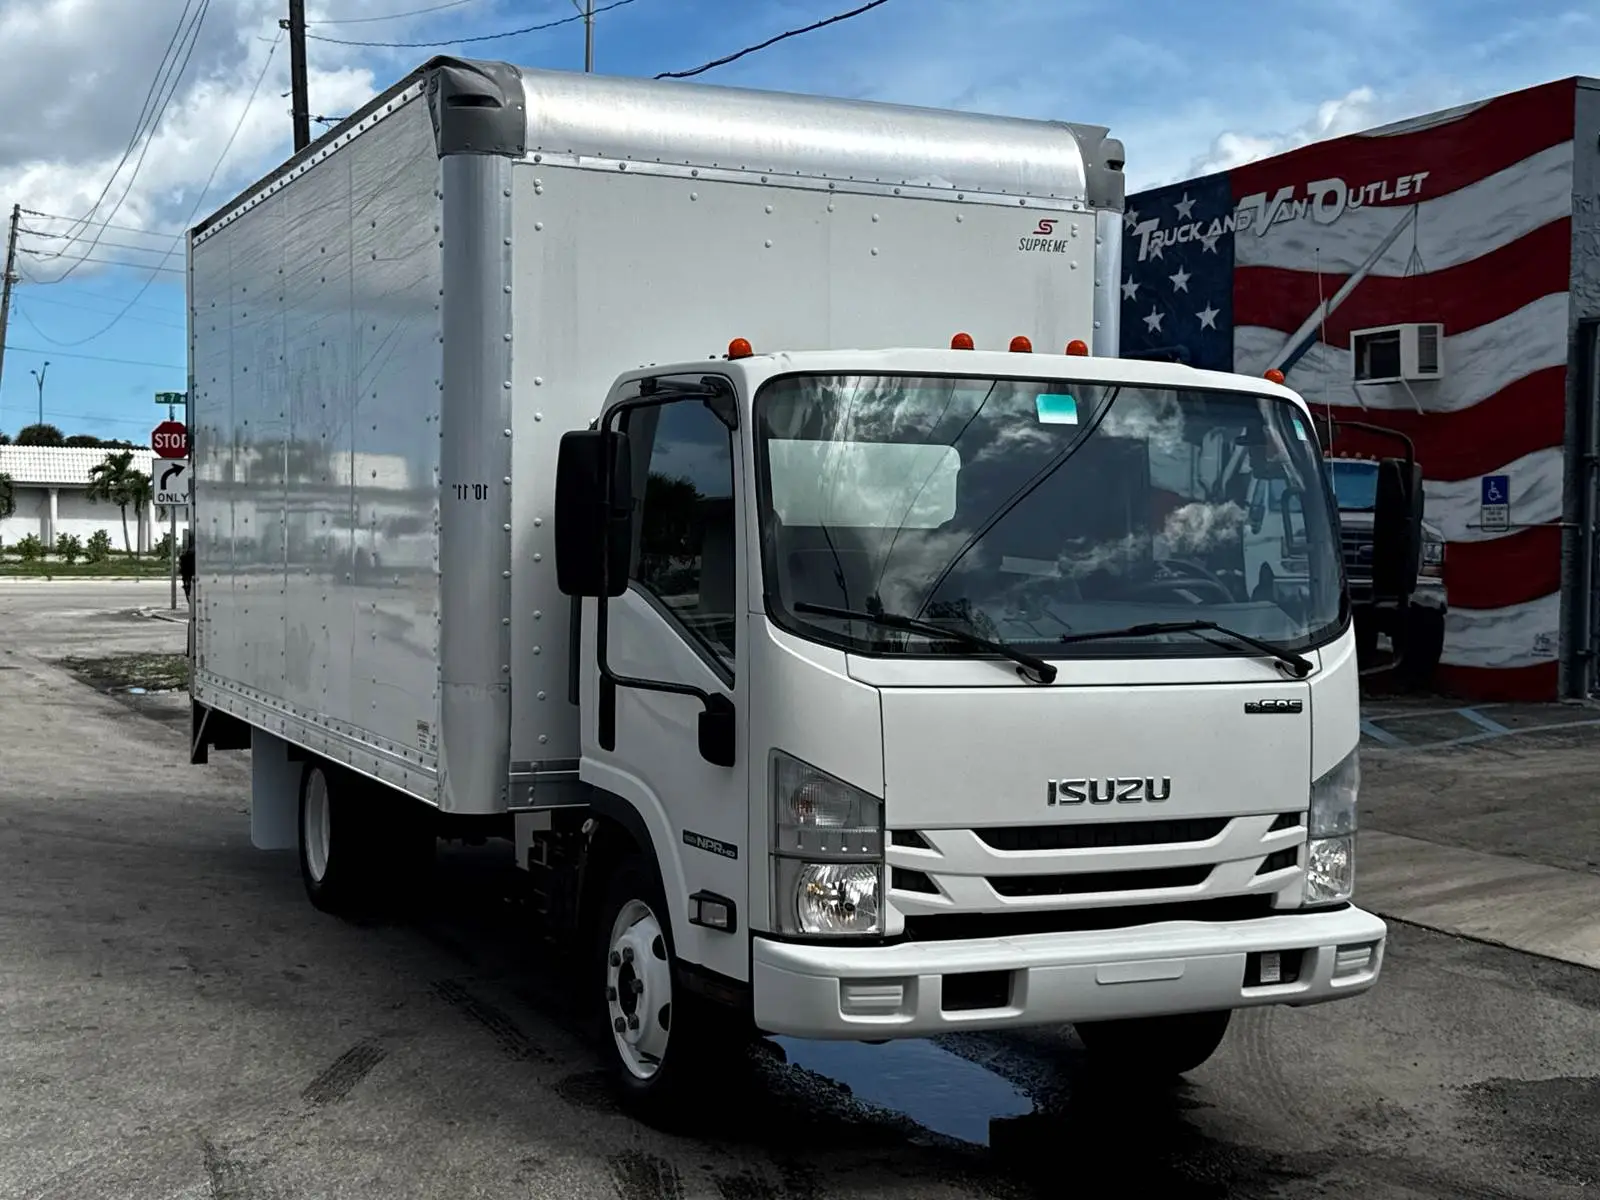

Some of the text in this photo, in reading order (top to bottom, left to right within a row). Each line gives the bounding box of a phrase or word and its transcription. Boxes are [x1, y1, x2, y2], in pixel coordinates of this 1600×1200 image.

[1307, 171, 1430, 226] OUTLET
[1018, 237, 1068, 253] SUPREME
[157, 493, 190, 503] ONLY
[1047, 776, 1171, 806] ISUZU
[697, 835, 723, 854] NPR
